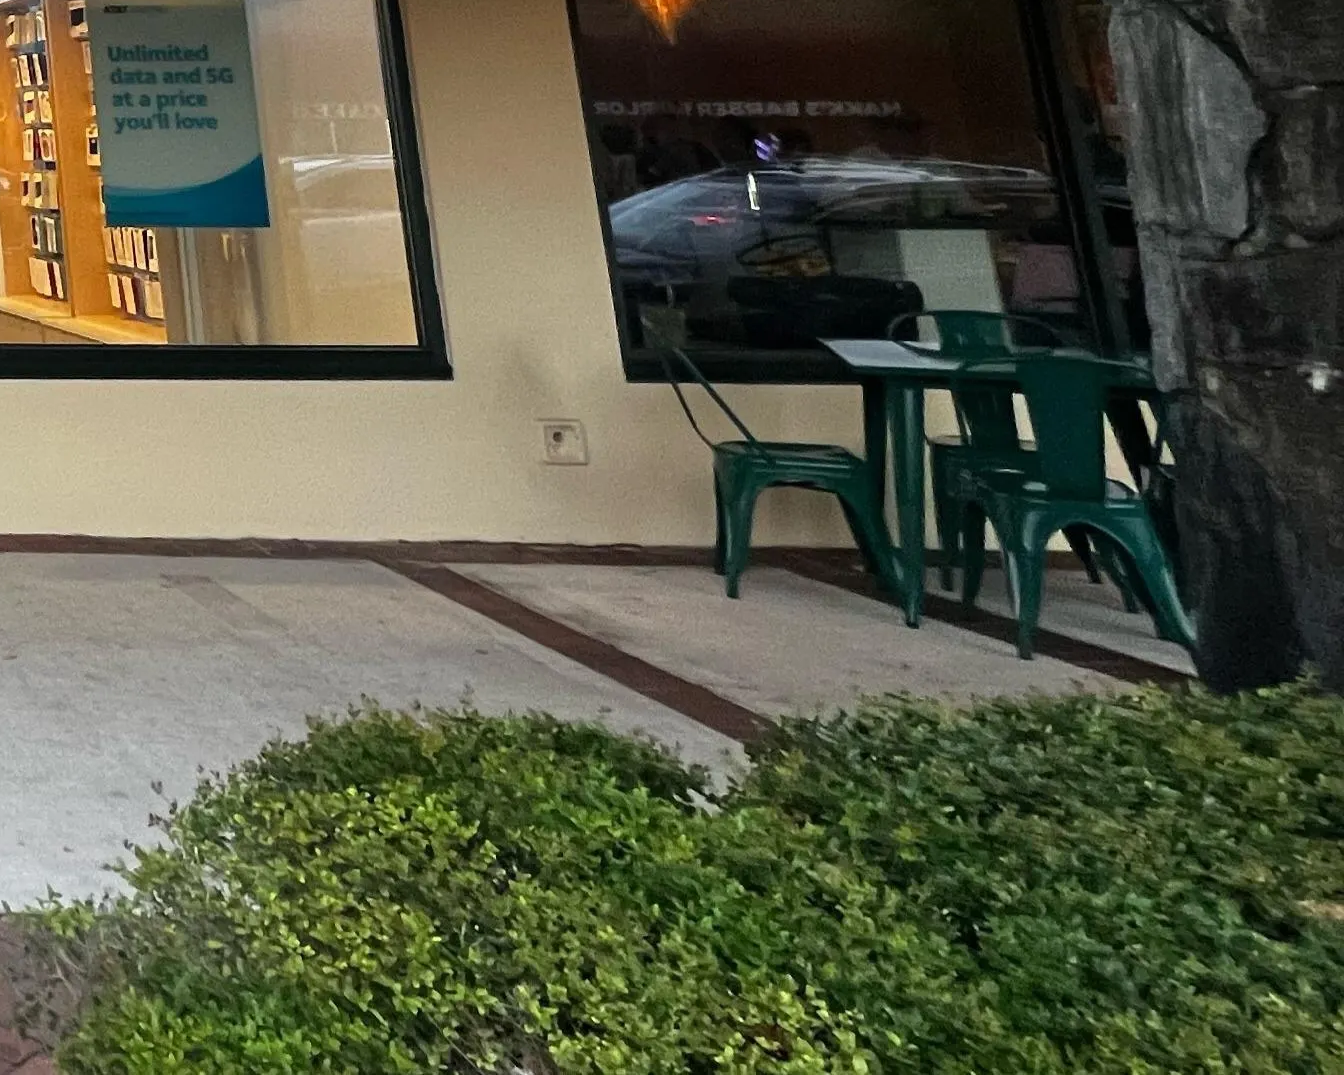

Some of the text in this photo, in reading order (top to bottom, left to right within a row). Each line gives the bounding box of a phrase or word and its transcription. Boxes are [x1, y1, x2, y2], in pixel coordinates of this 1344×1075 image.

[108, 44, 209, 61] Unlimited
[111, 67, 234, 84] data and 5G
[112, 91, 208, 111] at a price
[114, 112, 218, 134] you'll love
